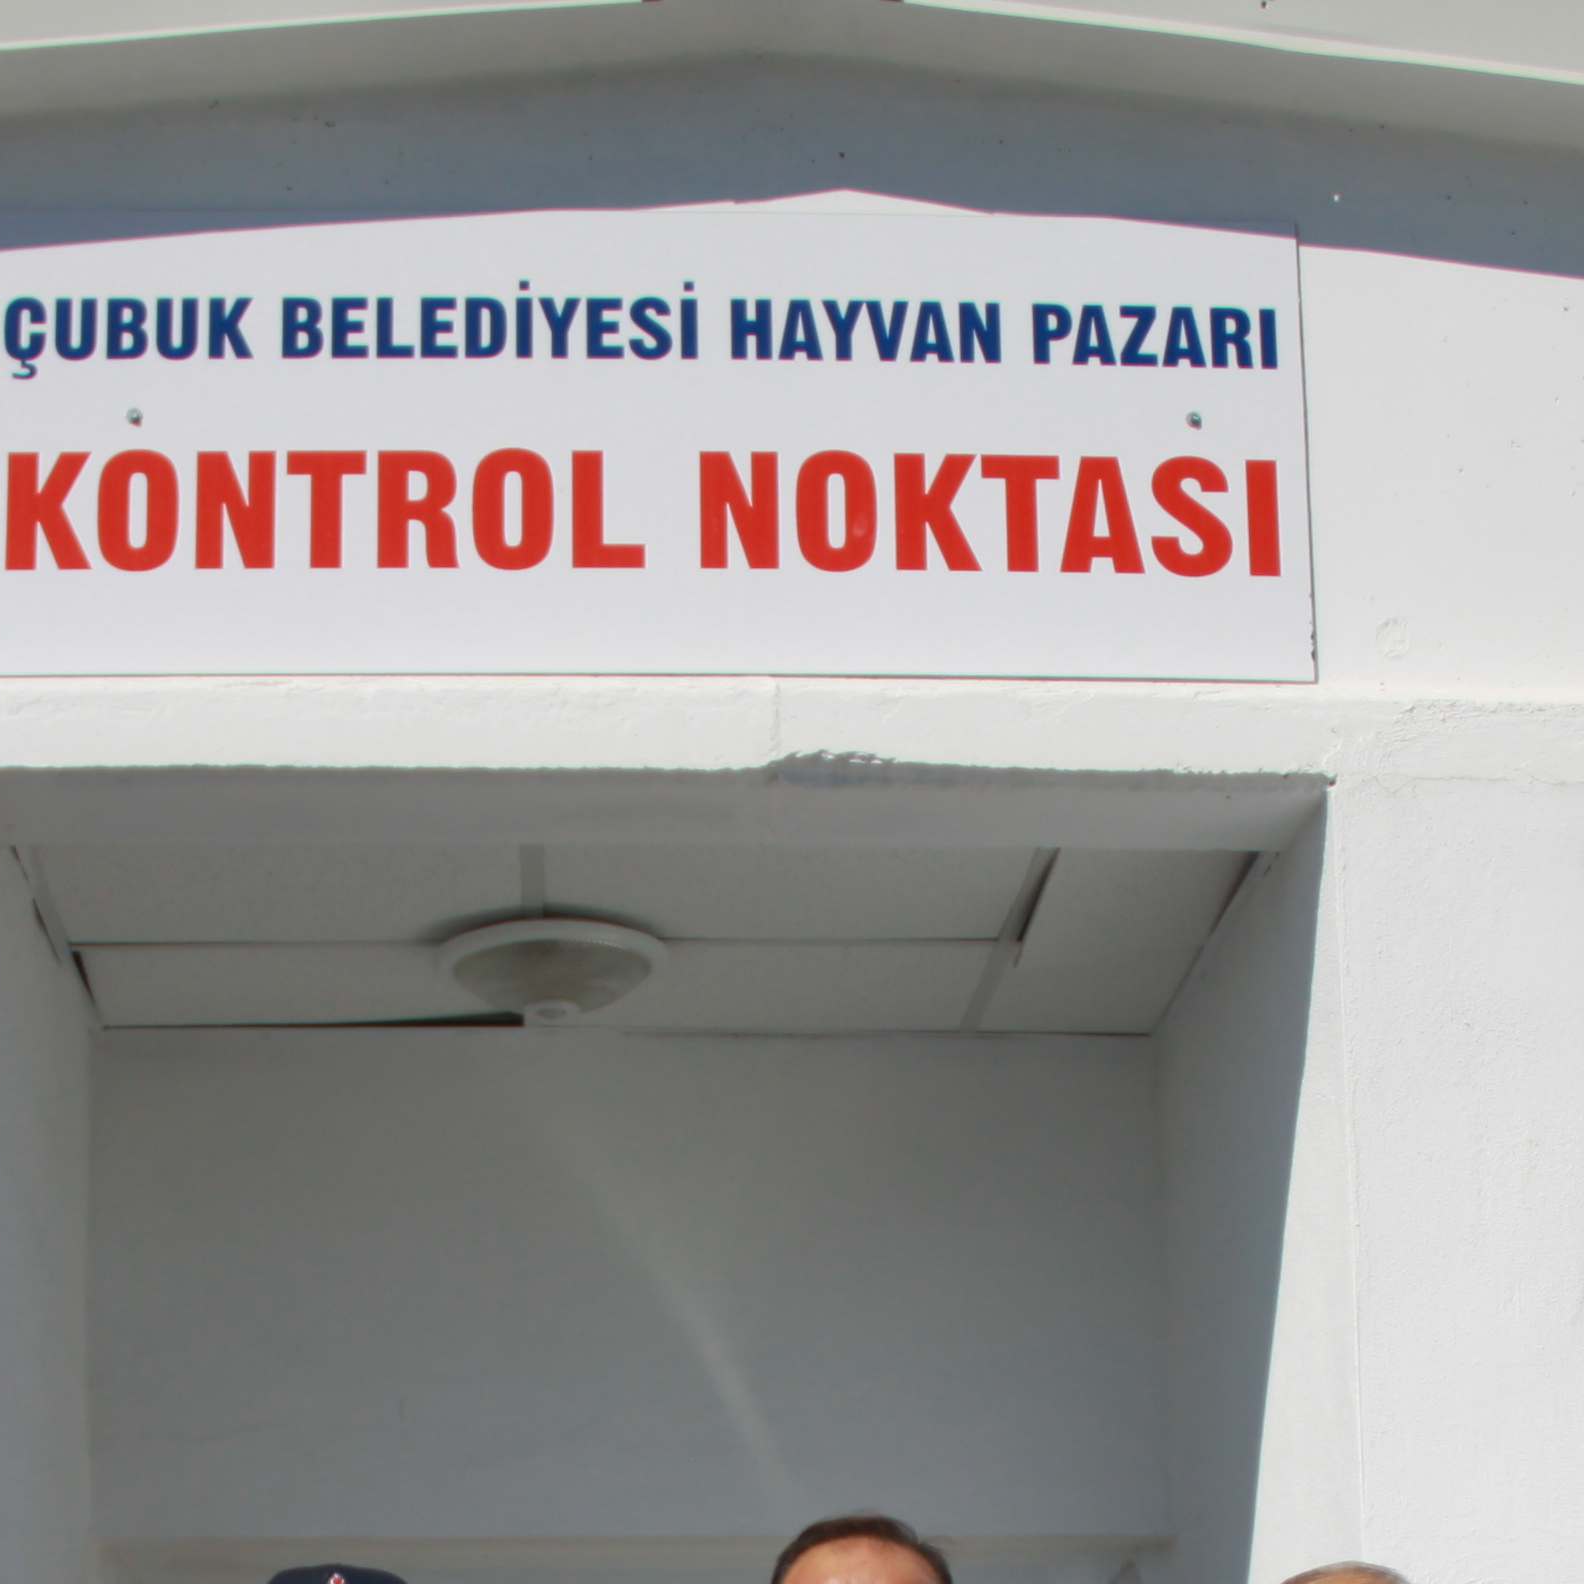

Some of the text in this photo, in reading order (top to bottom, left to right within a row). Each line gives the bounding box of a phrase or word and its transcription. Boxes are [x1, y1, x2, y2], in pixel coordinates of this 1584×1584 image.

[3, 280, 1279, 381] ÇUBUK BELEDİYESİ HAYVAN PAZARI
[4, 447, 1282, 578] KONTROL NOKTASI
